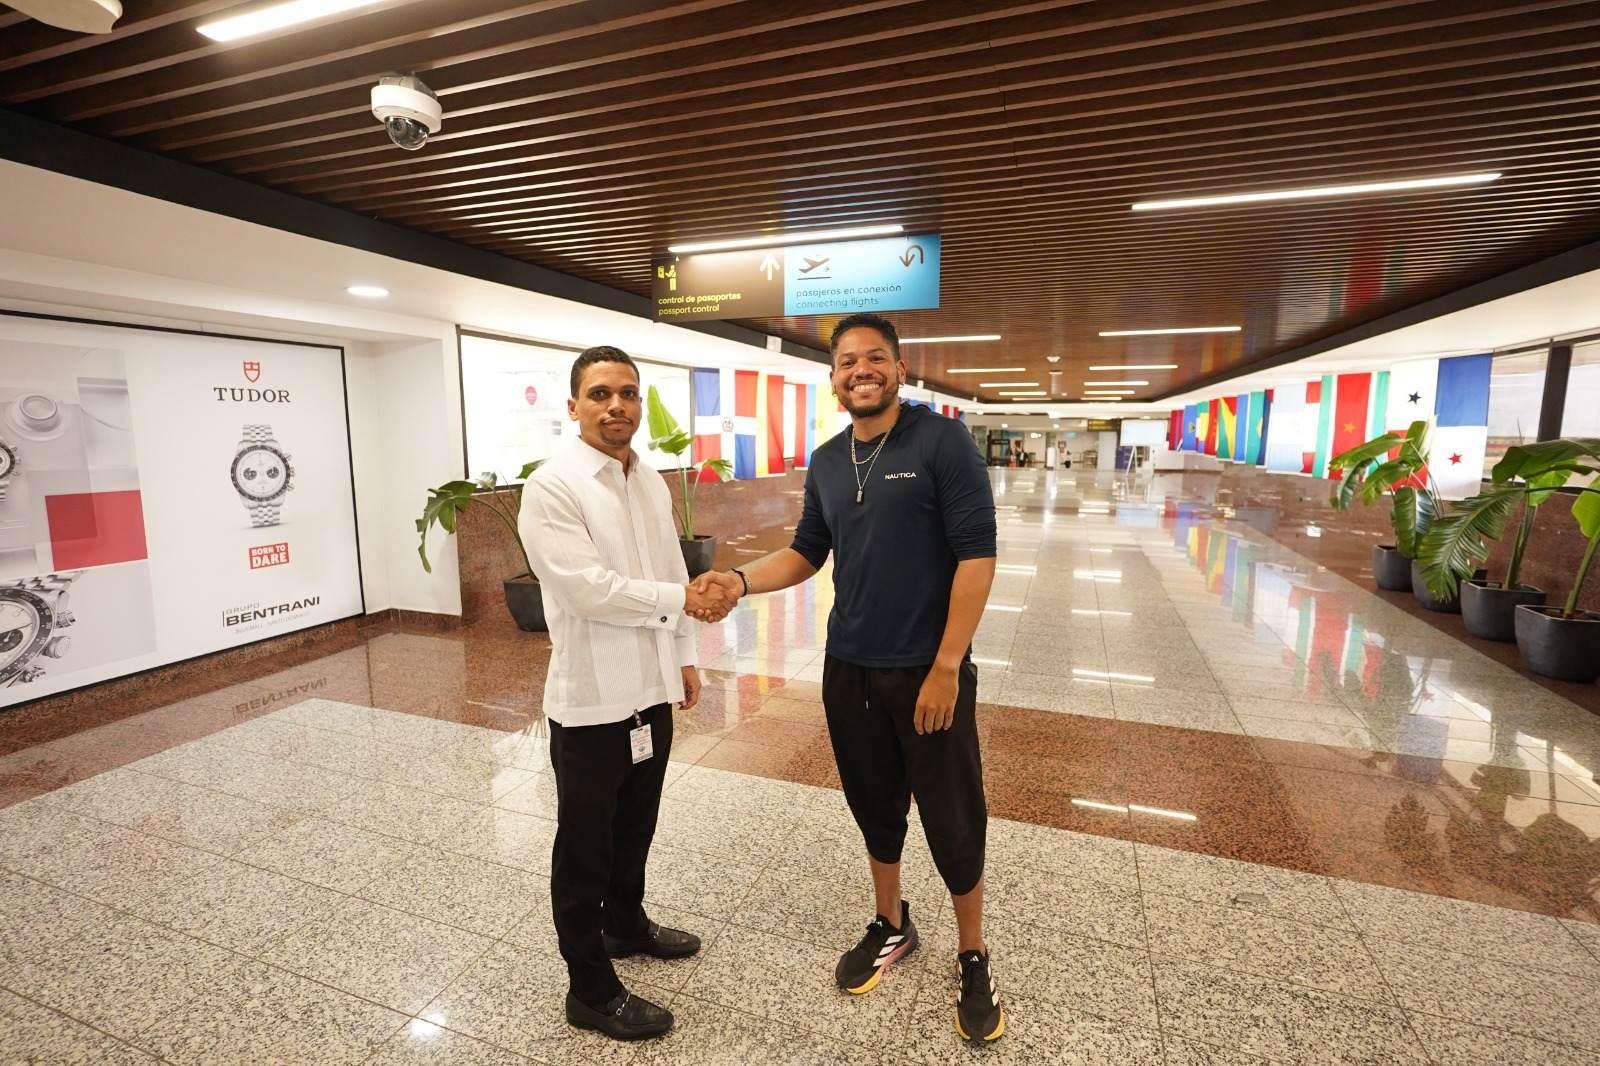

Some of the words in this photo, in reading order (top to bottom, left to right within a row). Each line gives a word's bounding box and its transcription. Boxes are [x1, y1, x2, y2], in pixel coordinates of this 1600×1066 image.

[796, 287, 841, 299] pasajeros
[843, 287, 856, 295] en
[857, 283, 902, 294] conexión
[658, 296, 685, 305] control
[685, 295, 696, 303] de
[696, 292, 742, 304] pasaportes
[795, 299, 848, 309] connecting
[850, 297, 879, 308] flights
[658, 306, 691, 316] passport
[692, 304, 720, 313] control
[213, 387, 291, 403] TUDOR
[884, 472, 917, 480] NAUTICA
[251, 546, 274, 556] BORN
[275, 544, 286, 553] TO
[252, 552, 288, 568] DARE
[226, 602, 260, 615] GRUPO
[226, 596, 320, 626] BENTRANI
